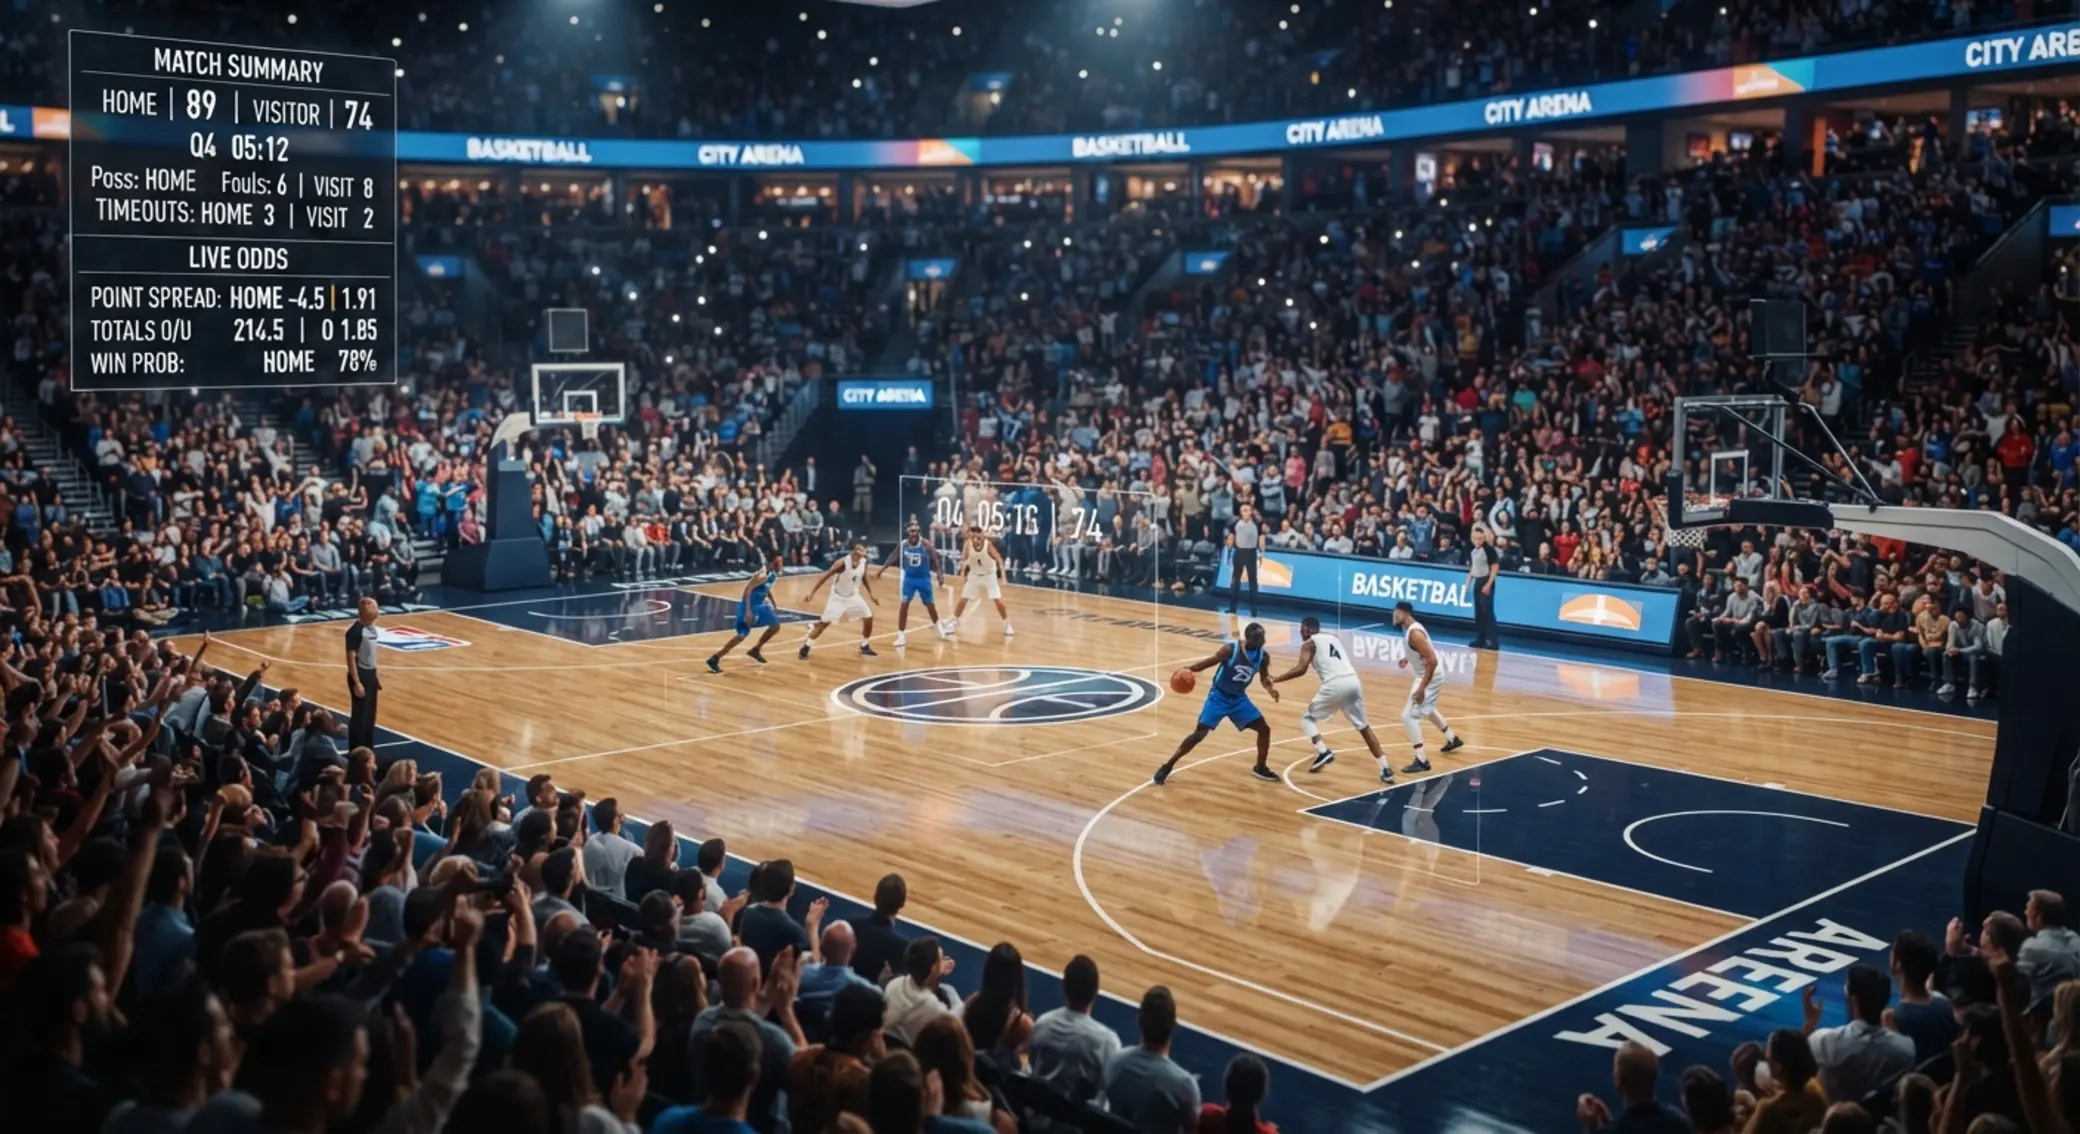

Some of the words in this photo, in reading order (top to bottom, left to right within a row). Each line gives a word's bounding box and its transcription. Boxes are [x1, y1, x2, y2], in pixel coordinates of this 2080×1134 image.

[1965, 36, 2025, 68] CITY
[1484, 101, 1525, 124] CITY
[1527, 91, 1592, 119] ARENA
[1286, 121, 1325, 144] CITY
[1325, 115, 1385, 141] ARENA
[466, 138, 592, 163] BASKETBALL
[699, 145, 740, 165] CITY
[1072, 133, 1190, 158] BASKETBALL
[843, 387, 876, 403] CITY
[1351, 572, 1473, 608] BASKETBAL
